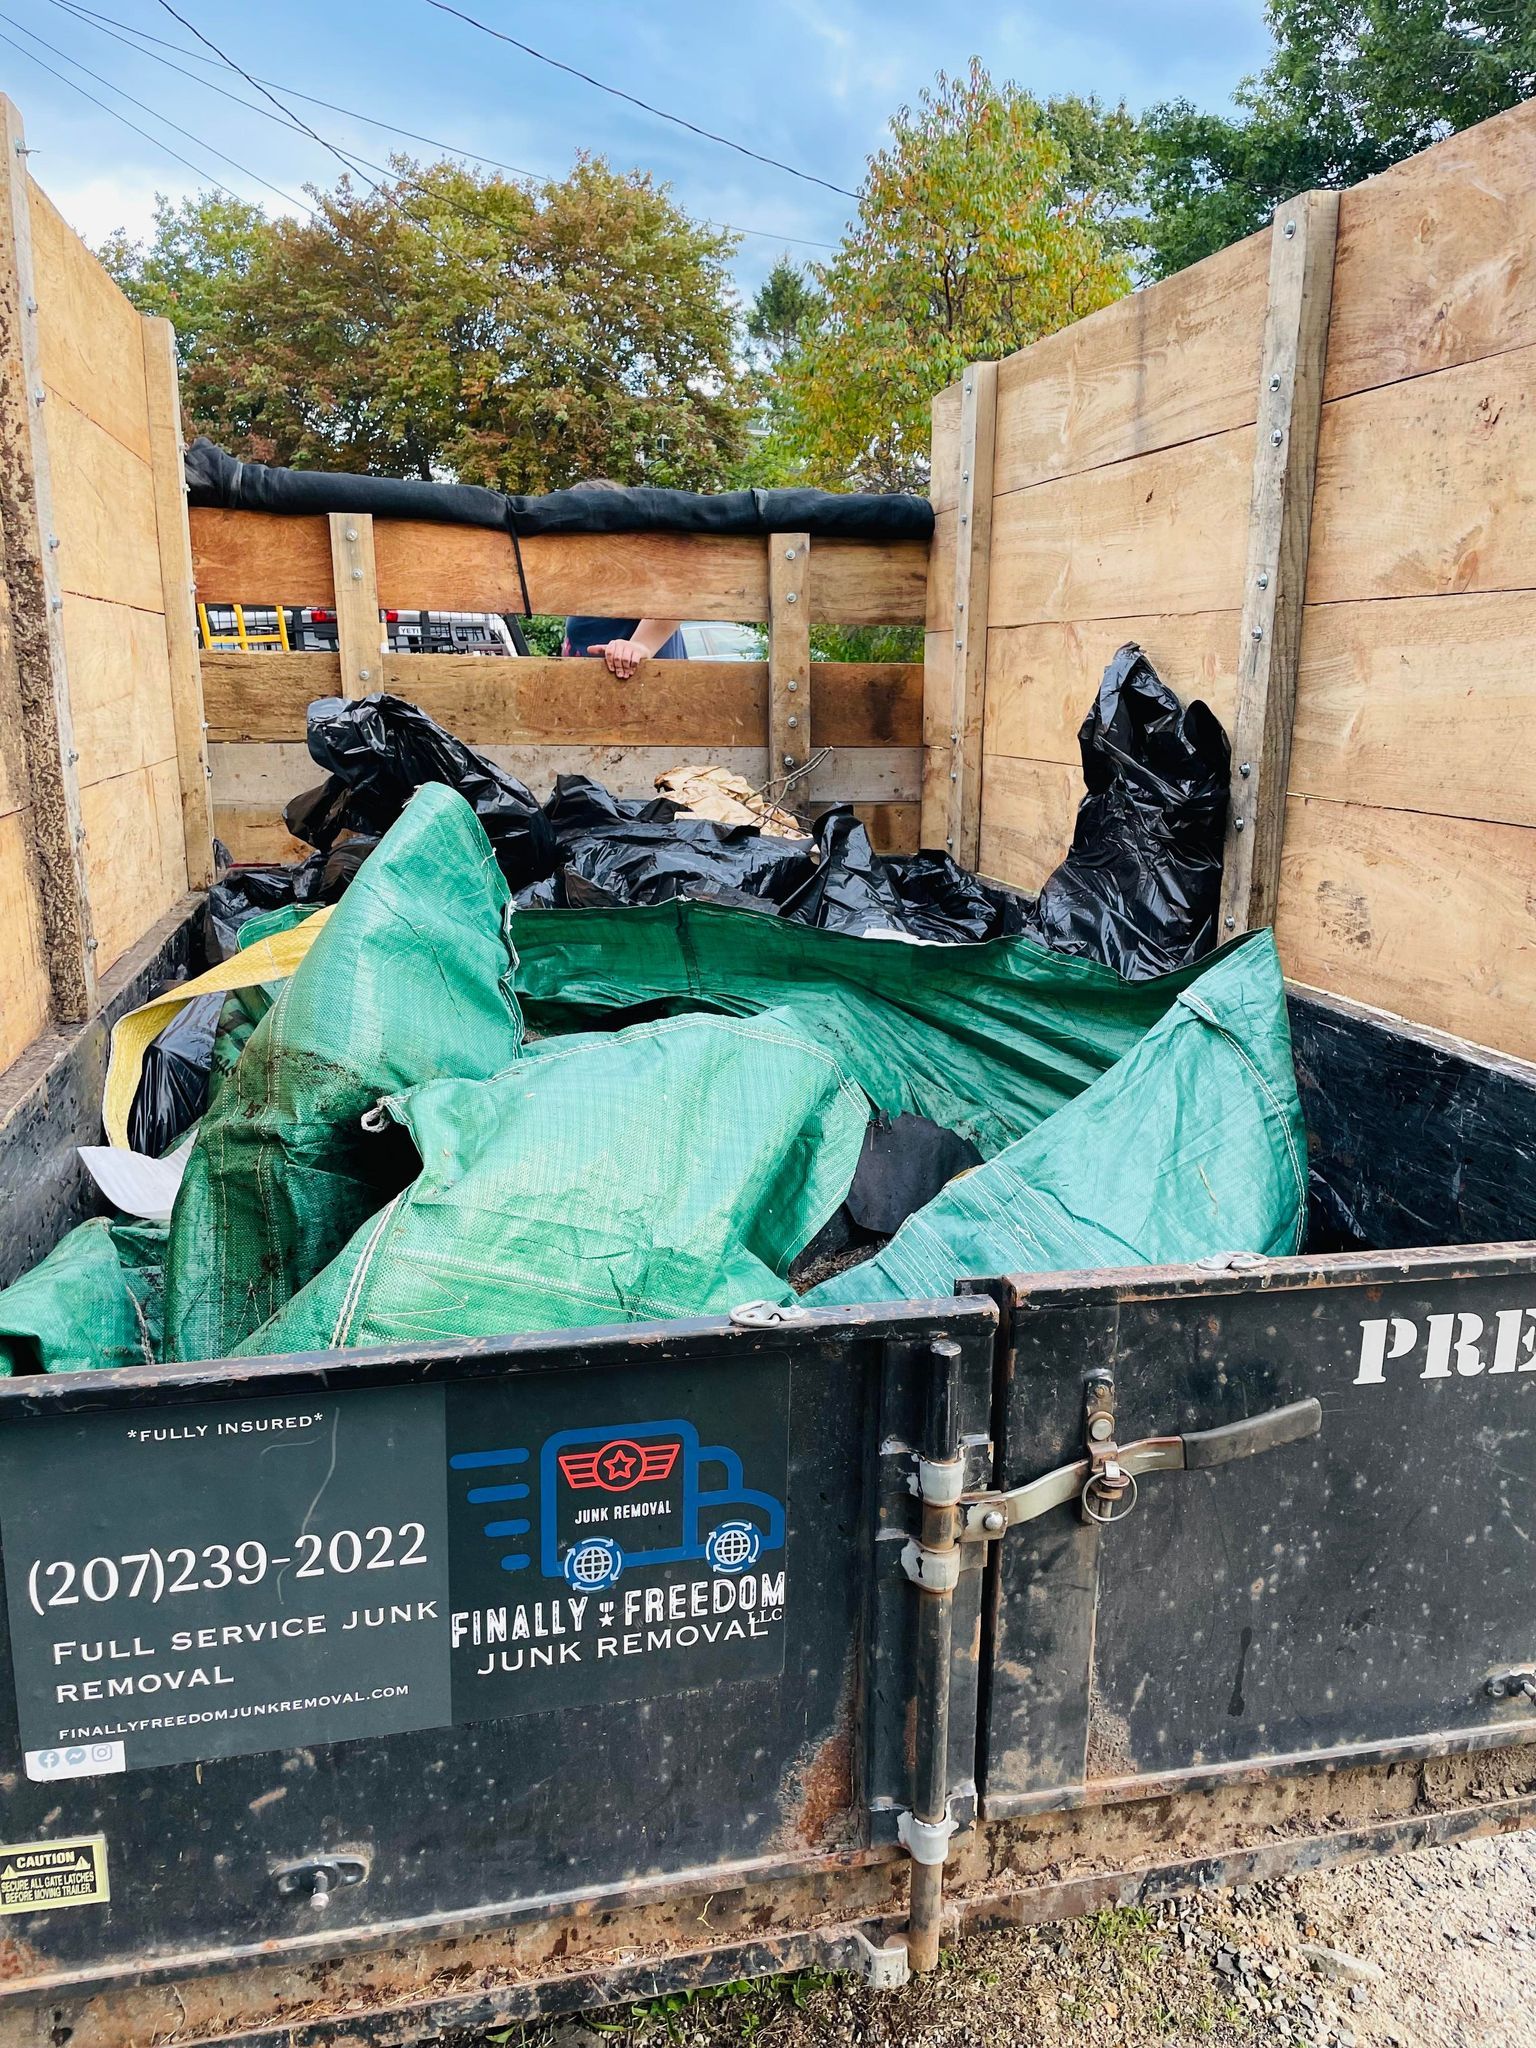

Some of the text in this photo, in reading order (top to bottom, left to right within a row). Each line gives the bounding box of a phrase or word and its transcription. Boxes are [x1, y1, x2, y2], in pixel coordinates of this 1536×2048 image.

[1353, 1308, 1536, 1385] PRE
[574, 1500, 672, 1525] JUNK REMOVAL
[28, 1521, 428, 1616] (207)239-2022
[52, 1600, 439, 1665] FULL SERVICE JUNK
[451, 1571, 786, 1649] FINALLY FREEDOM
[747, 1608, 783, 1625] LLC
[477, 1616, 769, 1676] JUNK REMOVAL
[55, 1665, 235, 1704] REMOVAL
[58, 1684, 410, 1740] FINALLYFREEDOMJUNKREMOVAL.COM
[1, 1871, 94, 1893] SECURE ALL GATE LATCHES
[16, 1851, 75, 1869] CAUTION
[5, 1883, 93, 1904] BEFORE MOVING TRAILER.
